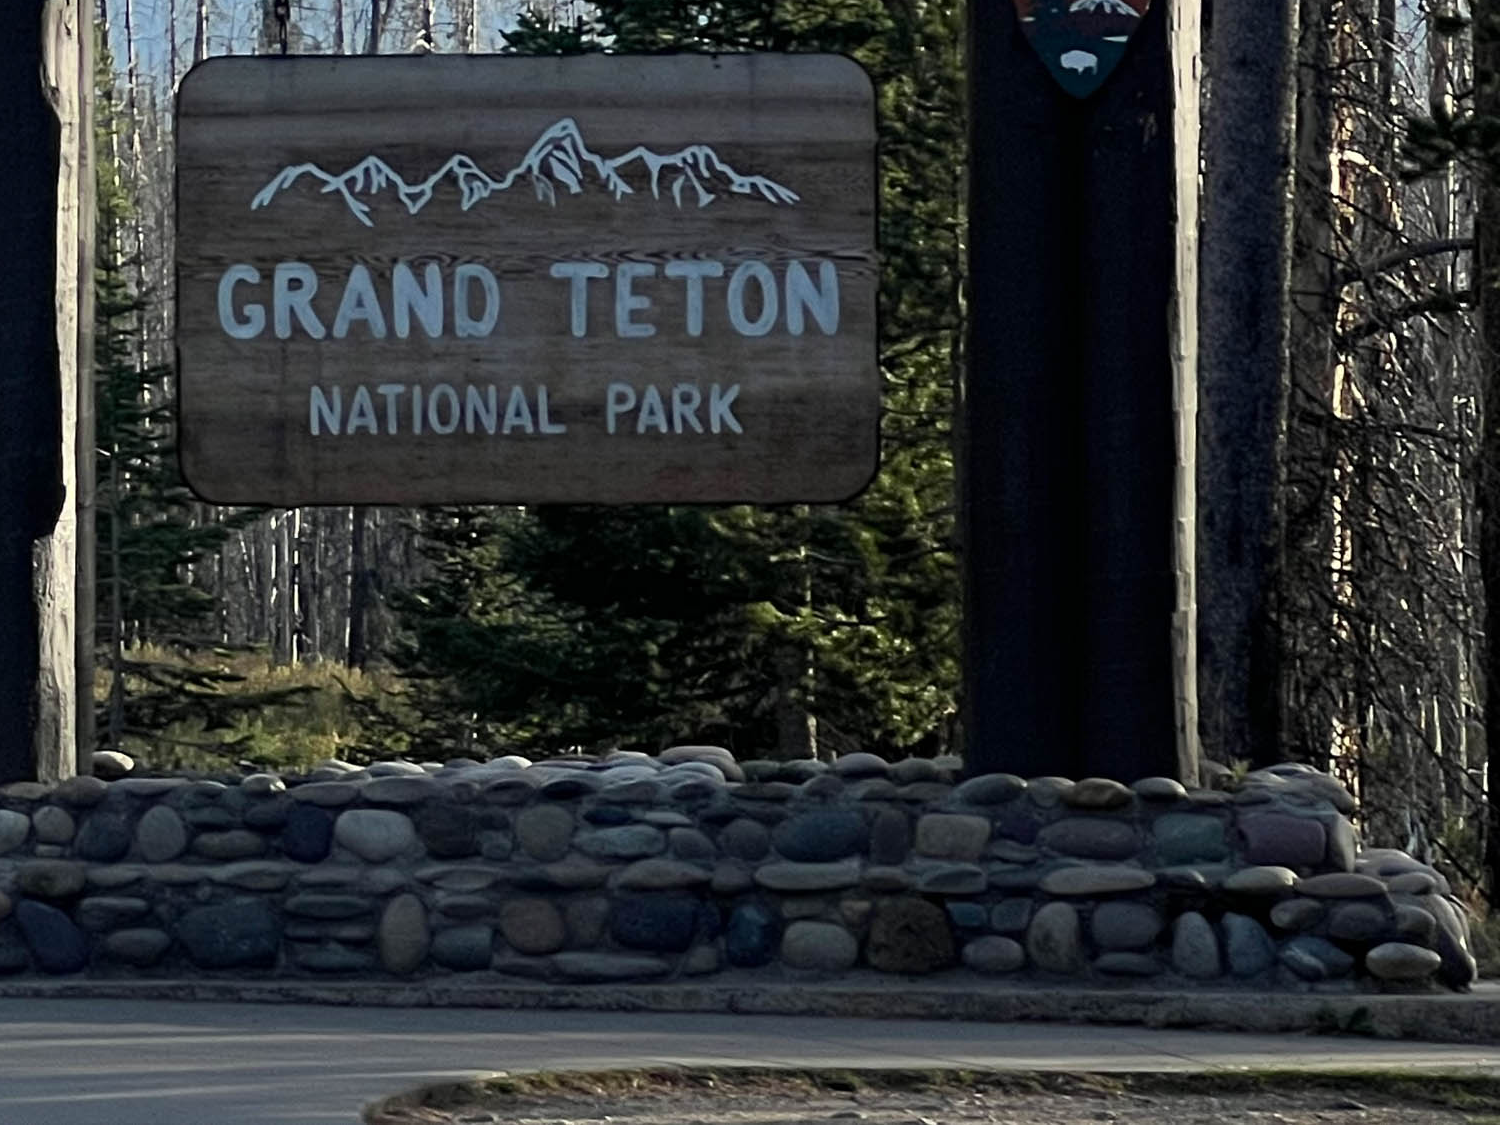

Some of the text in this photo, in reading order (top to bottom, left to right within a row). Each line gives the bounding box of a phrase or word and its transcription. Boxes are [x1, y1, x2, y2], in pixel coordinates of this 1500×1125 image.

[217, 260, 840, 340] GRAND TETON
[309, 383, 744, 435] NATIONAL PARK
